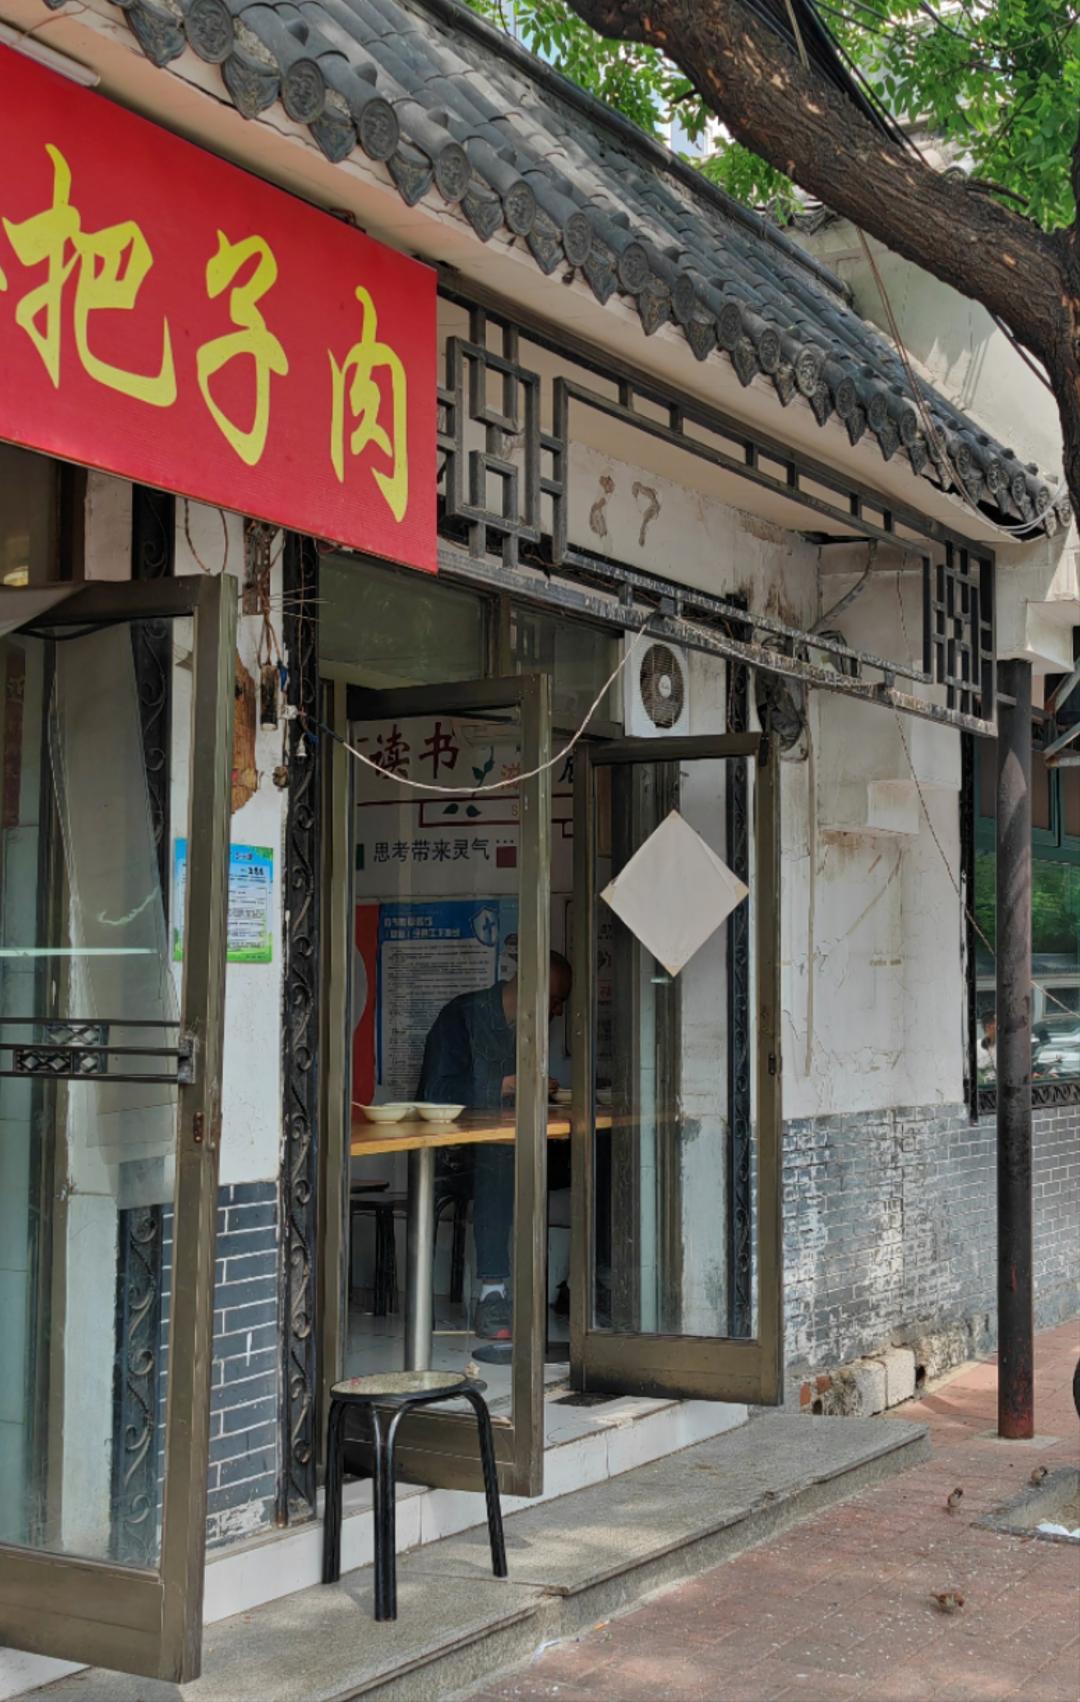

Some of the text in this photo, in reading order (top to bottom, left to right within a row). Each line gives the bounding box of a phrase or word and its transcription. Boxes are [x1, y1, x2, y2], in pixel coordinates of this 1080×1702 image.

[0, 143, 408, 520] 把子肉
[357, 721, 460, 780] 读书
[373, 837, 490, 862] 思考带来灵气
